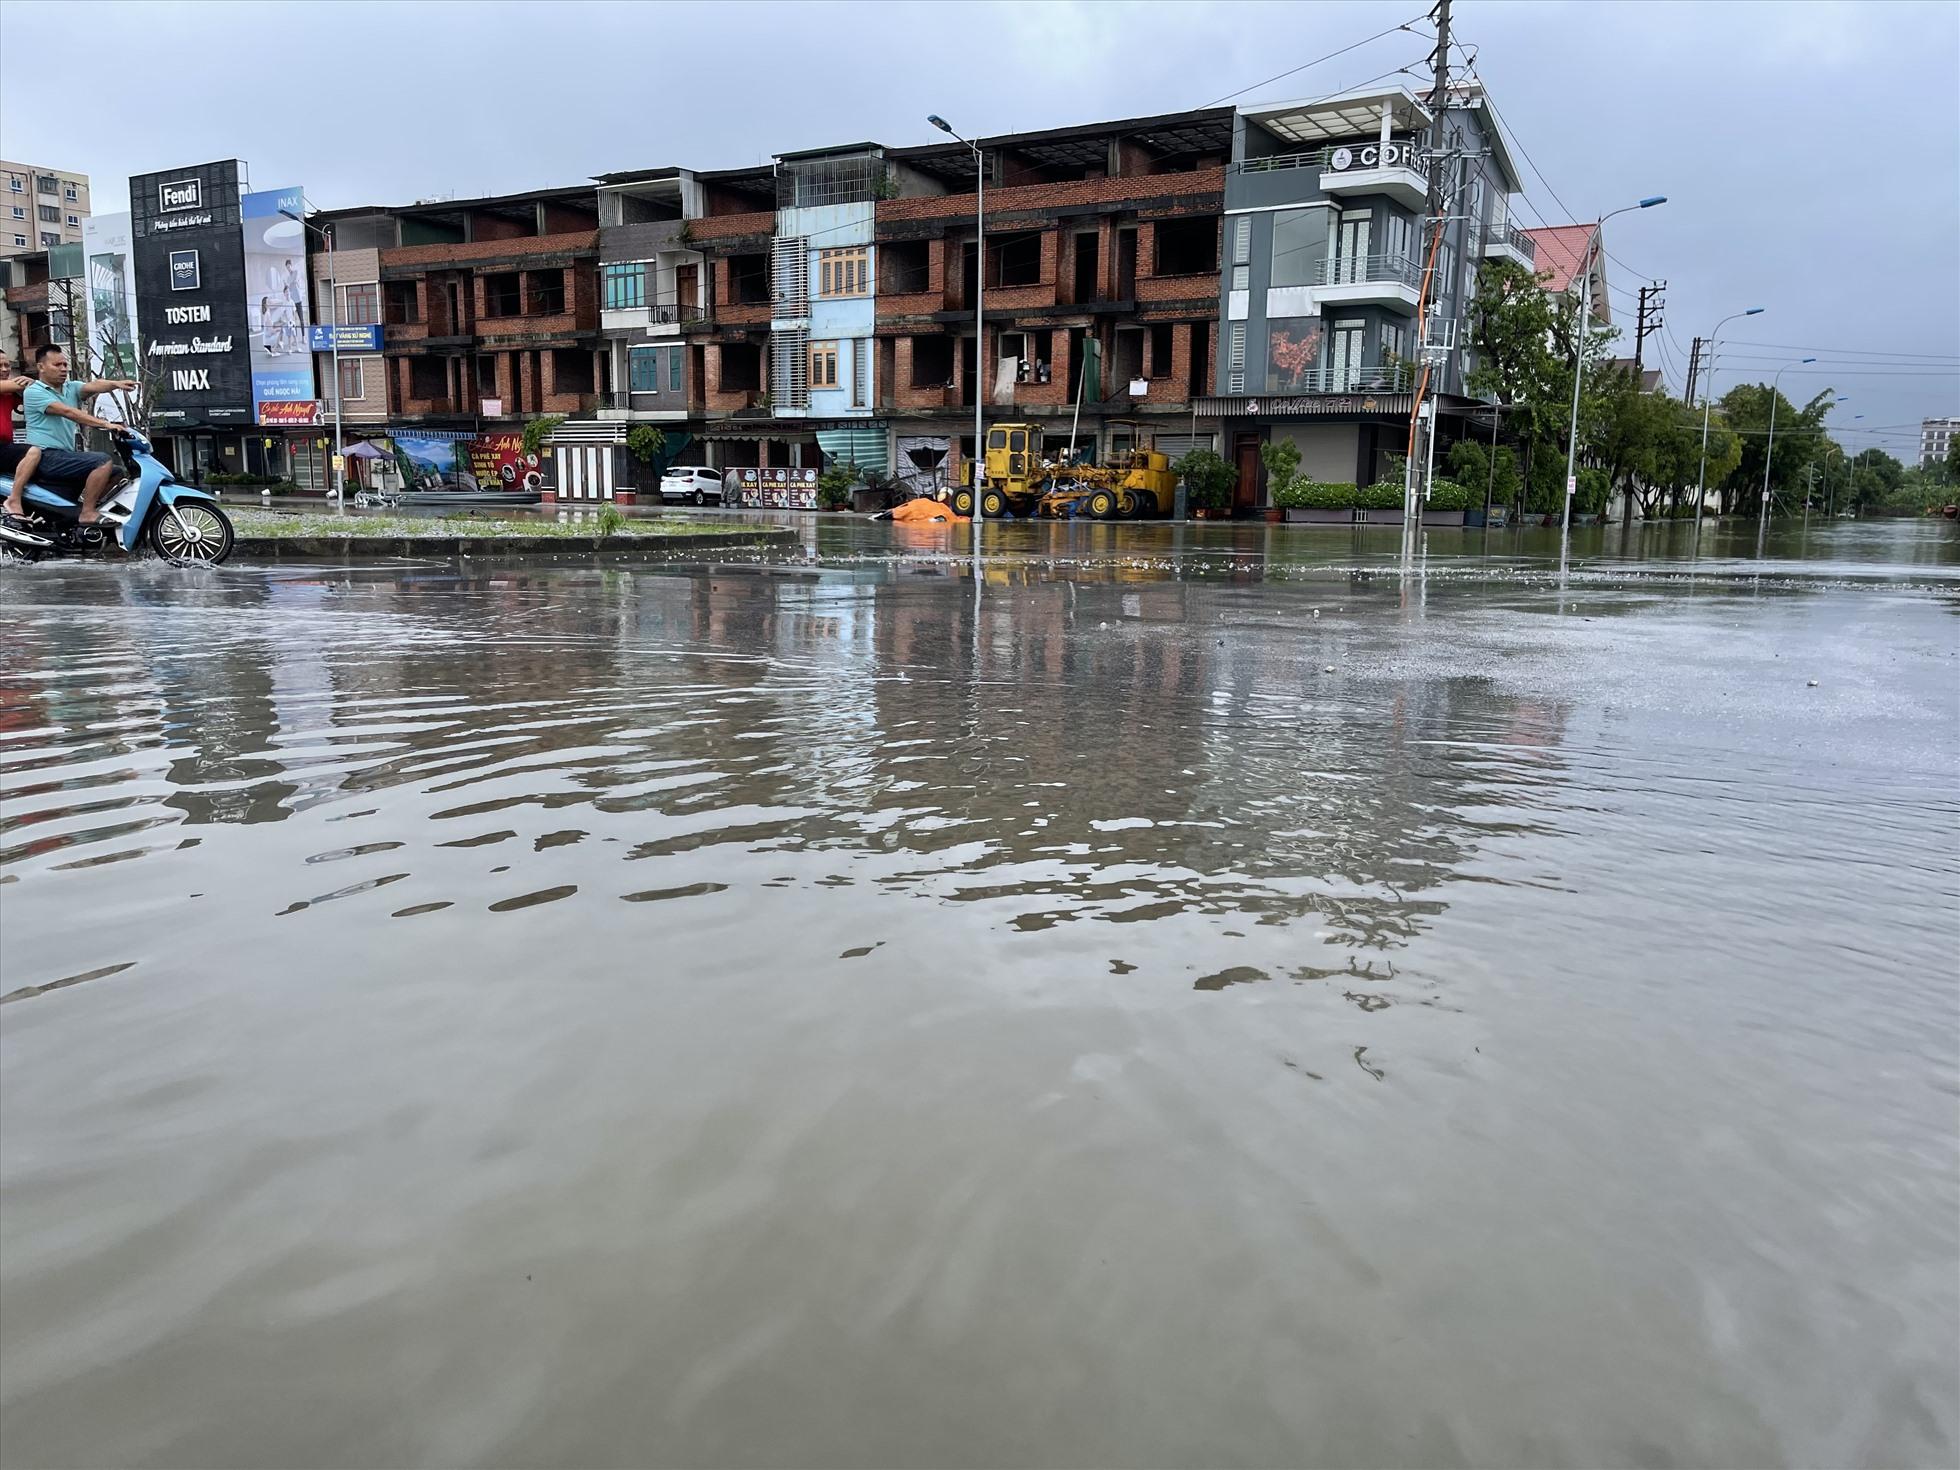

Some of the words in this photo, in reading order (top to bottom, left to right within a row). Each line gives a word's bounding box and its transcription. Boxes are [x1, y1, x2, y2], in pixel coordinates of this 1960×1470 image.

[164, 184, 197, 206] Fendi
[278, 196, 298, 209] INAX
[173, 261, 195, 271] GROHE
[165, 305, 211, 325] TOSTEM
[190, 335, 233, 354] Standard
[172, 369, 211, 391] INAX
